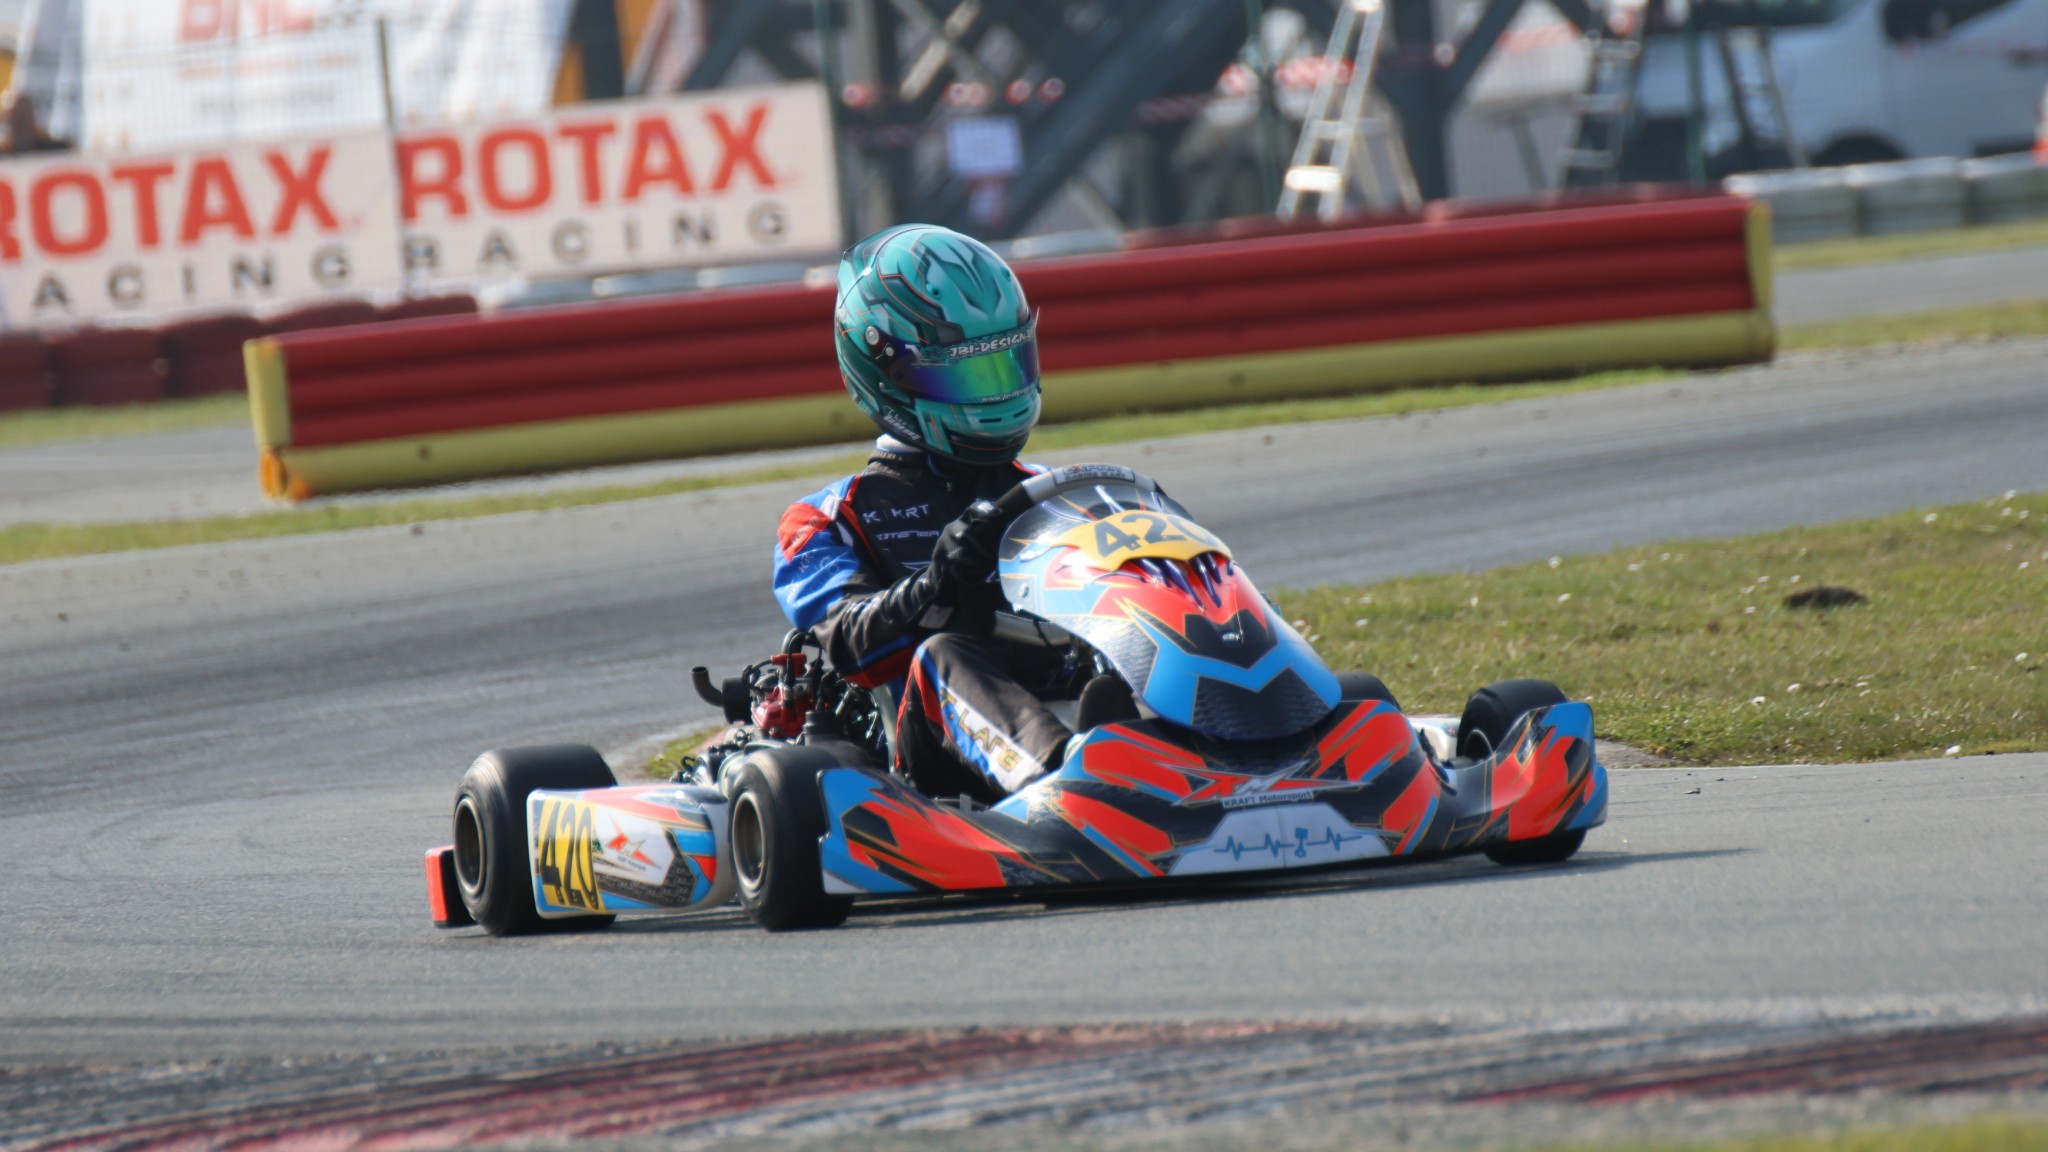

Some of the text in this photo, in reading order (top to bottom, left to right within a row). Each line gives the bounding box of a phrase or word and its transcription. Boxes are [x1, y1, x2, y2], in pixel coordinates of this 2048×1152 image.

[396, 103, 777, 220] ROTAX
[402, 202, 791, 270] RACING
[540, 800, 599, 911] 420
